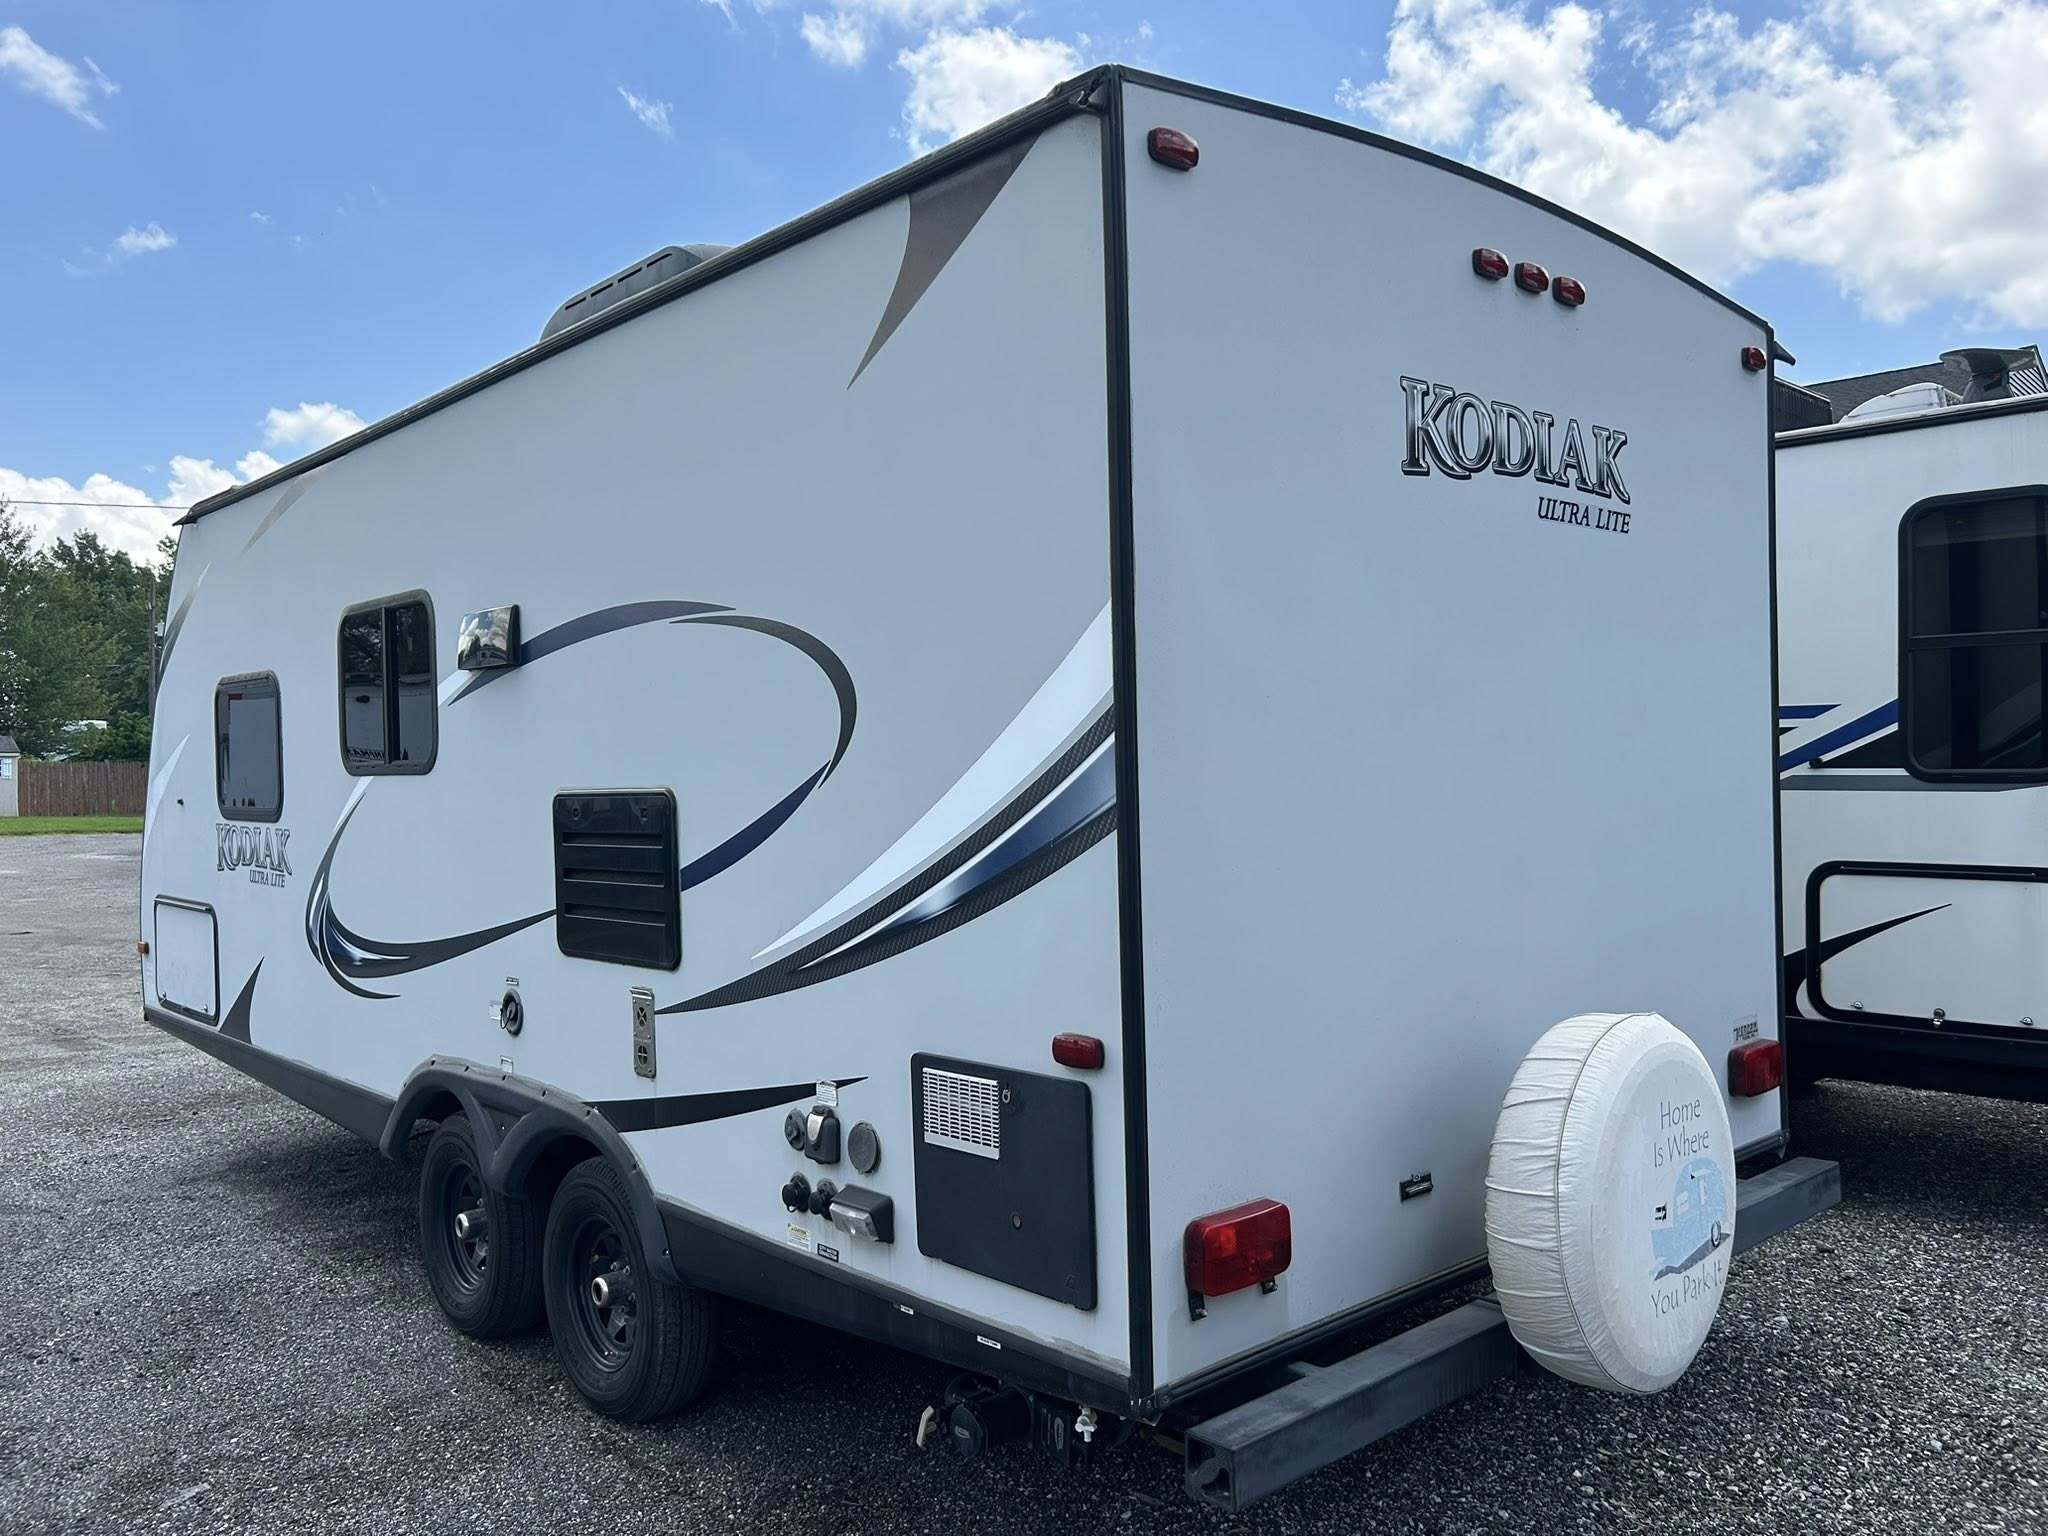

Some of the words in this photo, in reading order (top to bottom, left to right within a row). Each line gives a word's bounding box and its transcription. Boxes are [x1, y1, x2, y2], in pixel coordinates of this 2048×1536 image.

[1400, 376, 1630, 504] KODIAK
[1537, 496, 1590, 528] ULTRA
[1595, 507, 1631, 534] LITE
[215, 823, 293, 876] KODIAK
[249, 869, 269, 886] ULTRA
[270, 872, 286, 888] LITE
[1660, 1098, 1701, 1130] Home
[1653, 1141, 1664, 1168] Is
[1667, 1124, 1709, 1162] Where
[1651, 1289, 1679, 1318] You
[1683, 1263, 1710, 1303] Park
